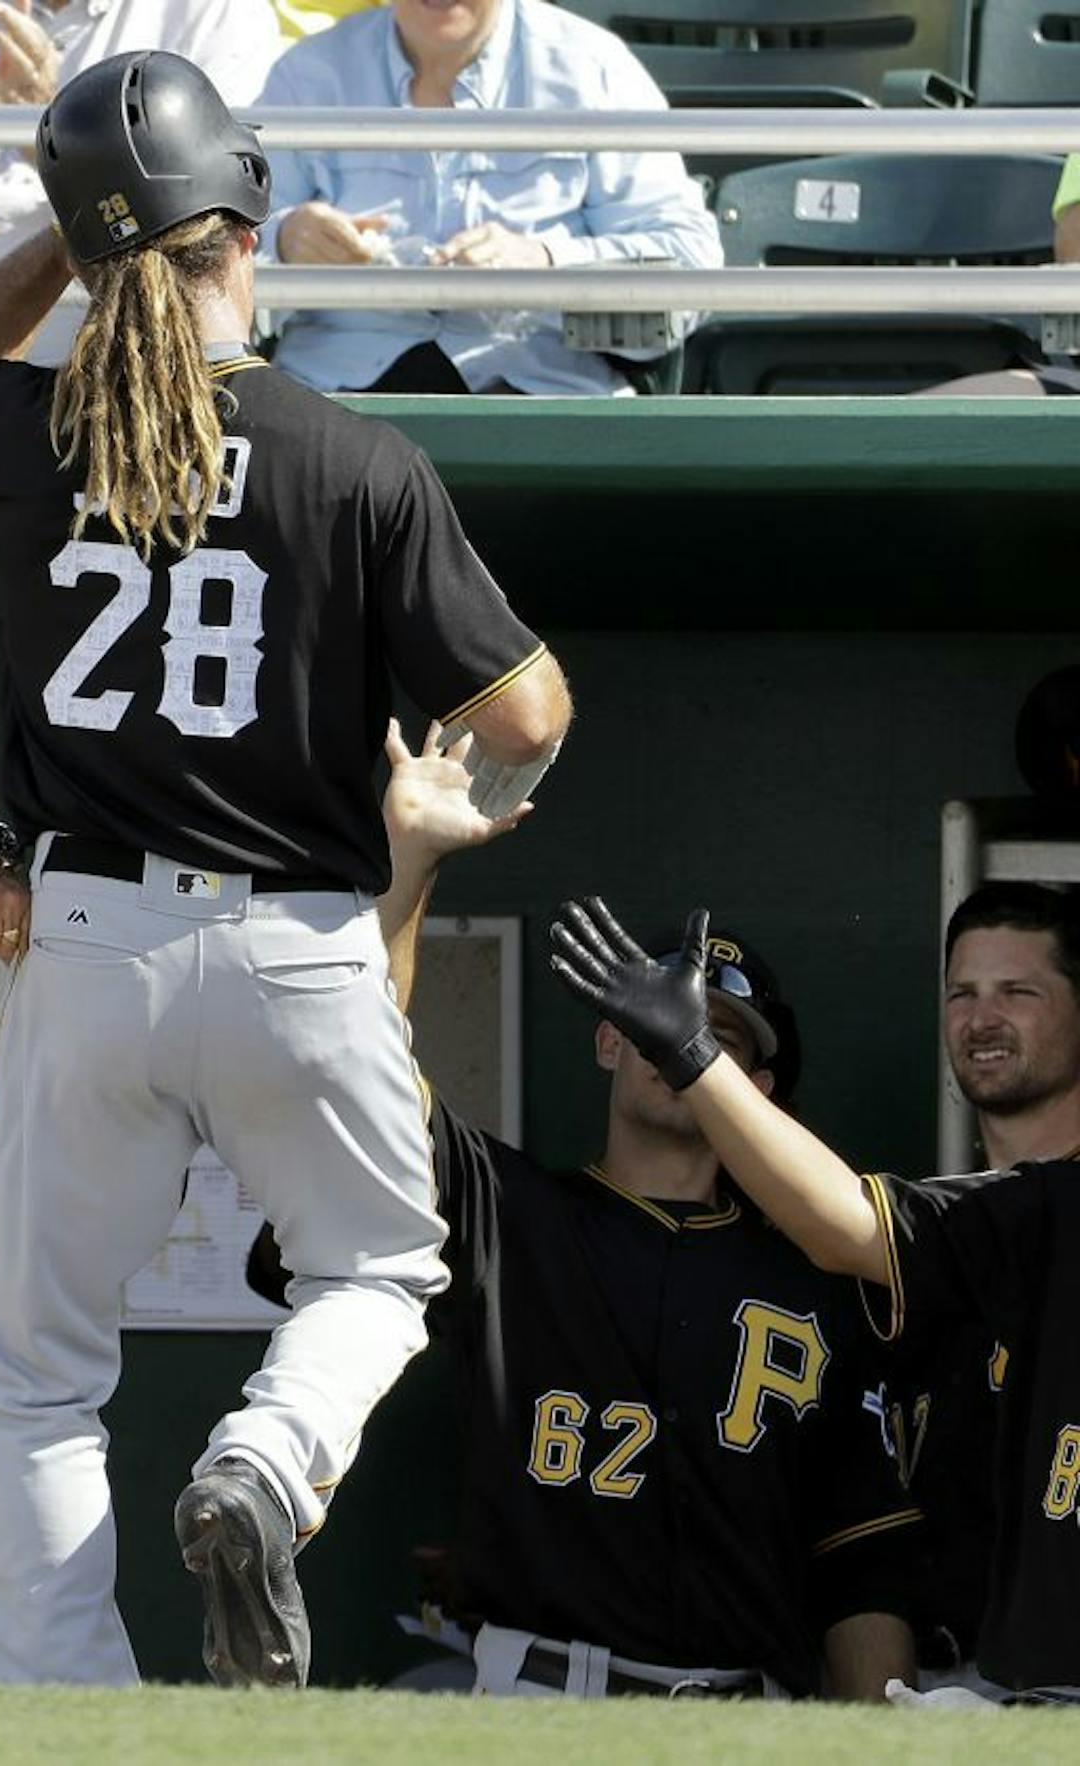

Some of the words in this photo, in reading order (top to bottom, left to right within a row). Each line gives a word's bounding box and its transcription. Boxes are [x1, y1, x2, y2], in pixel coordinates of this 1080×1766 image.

[98, 193, 129, 223] 28
[819, 185, 837, 219] 4
[42, 539, 269, 738] 28
[716, 1299, 831, 1453] P
[526, 1390, 658, 1499] 62
[1042, 1423, 1080, 1528] 8
